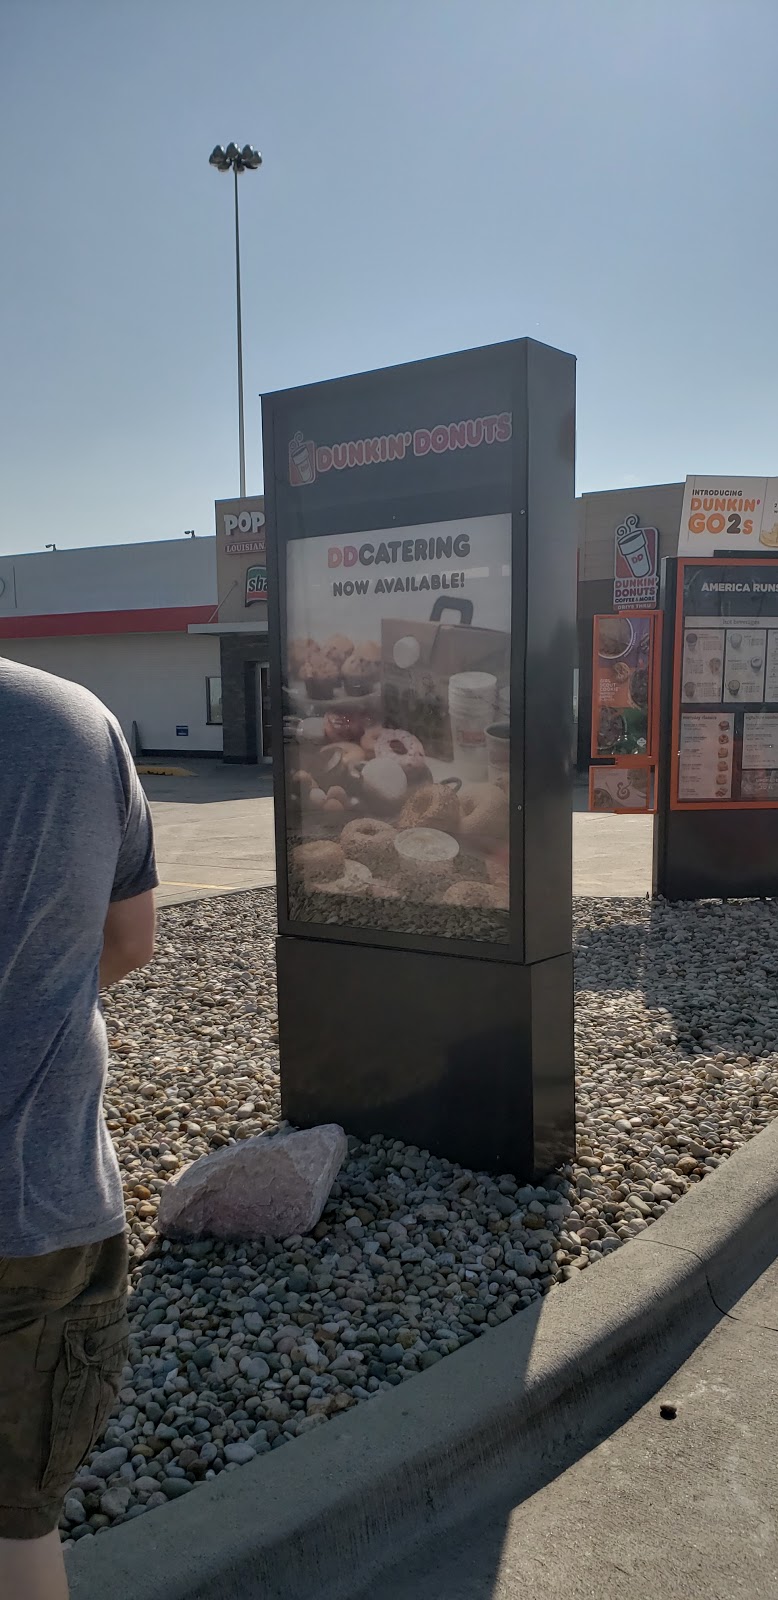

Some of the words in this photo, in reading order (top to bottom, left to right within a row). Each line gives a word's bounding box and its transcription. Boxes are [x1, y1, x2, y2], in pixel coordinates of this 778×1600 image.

[316, 432, 412, 472] DUNKIN'
[413, 412, 512, 456] DONUTS
[690, 498, 760, 512] DUNKIN'
[223, 511, 265, 536] POP
[226, 542, 265, 553] LOUISIAN
[333, 580, 369, 597] NOW
[374, 572, 465, 594] AVAILABLE!
[615, 577, 657, 588] DUNKIN'
[701, 582, 750, 592] AMERICA
[615, 587, 655, 597] DONUTS
